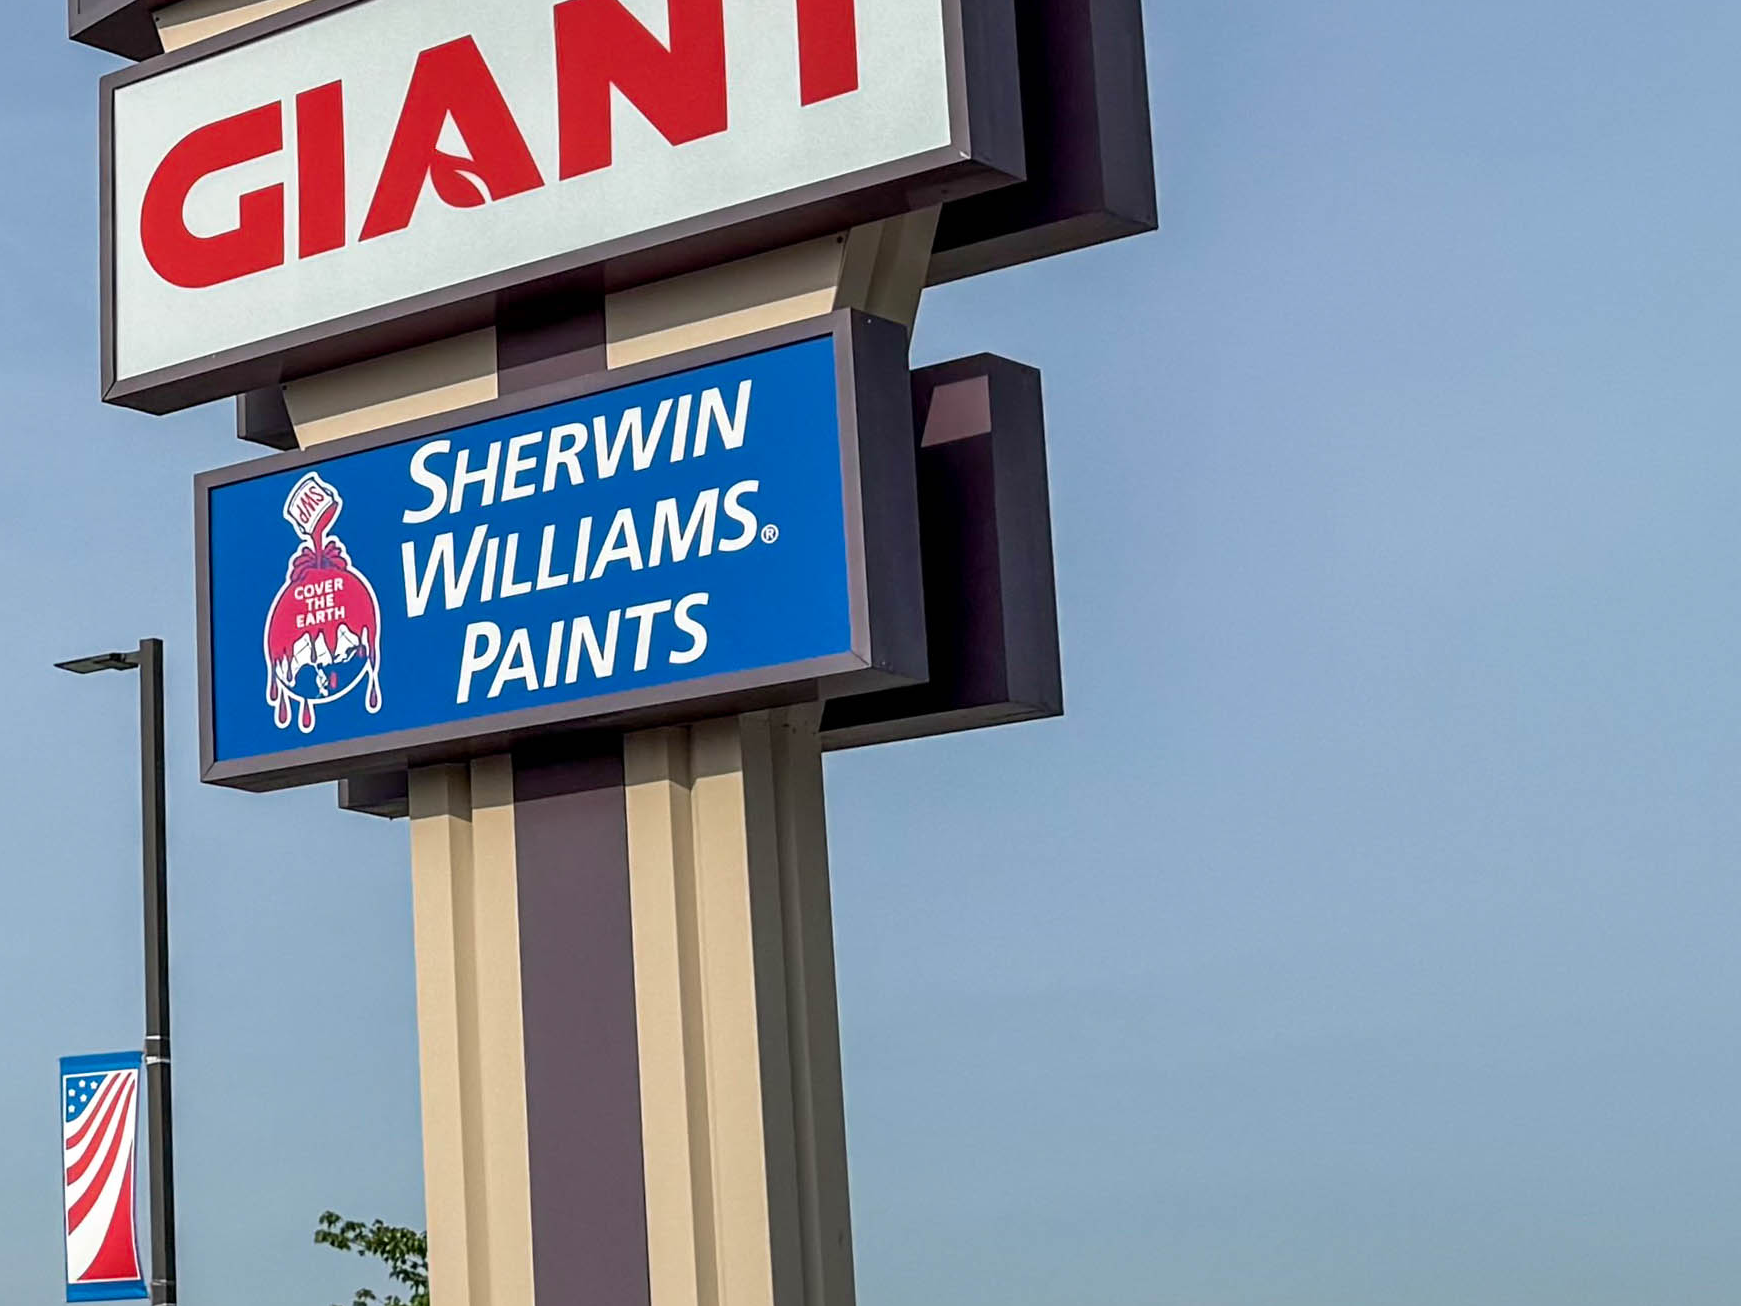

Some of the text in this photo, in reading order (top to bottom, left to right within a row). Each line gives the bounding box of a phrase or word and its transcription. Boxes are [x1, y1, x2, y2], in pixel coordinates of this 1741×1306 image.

[402, 379, 752, 524] SHERWIN
[294, 577, 344, 601] COVER
[305, 593, 335, 612] THE
[296, 605, 346, 629] EARTH
[455, 592, 710, 705] PAINTS
